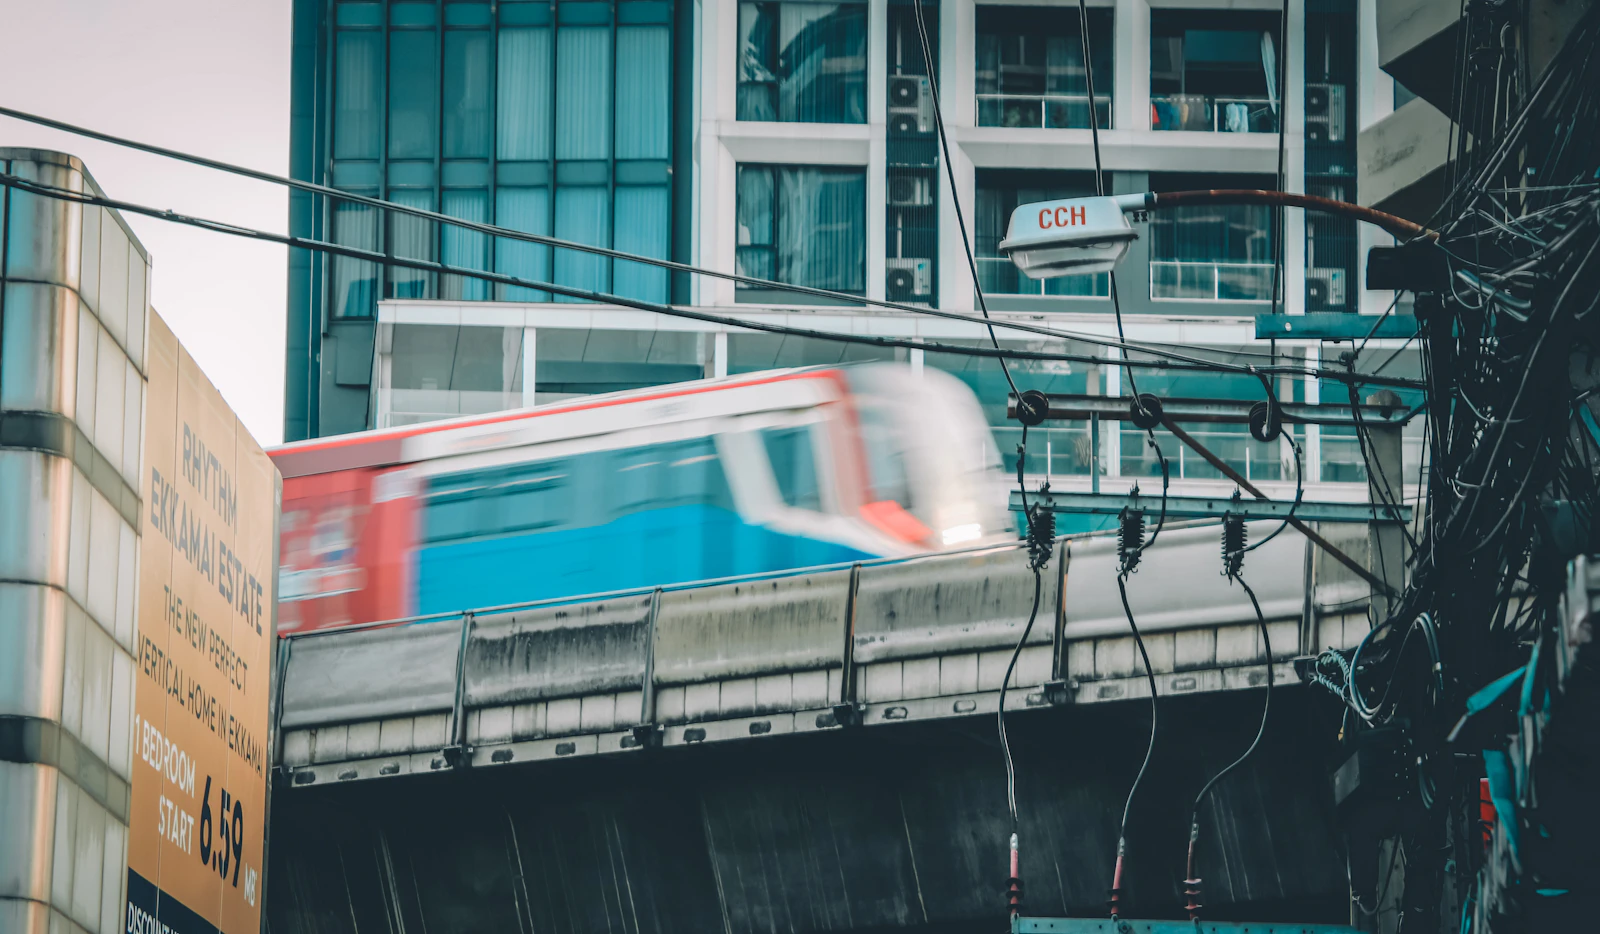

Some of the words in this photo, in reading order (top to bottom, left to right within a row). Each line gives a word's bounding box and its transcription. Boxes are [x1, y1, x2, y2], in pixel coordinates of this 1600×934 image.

[1038, 205, 1086, 229] CCH
[182, 421, 237, 532] RHYTHM
[151, 466, 215, 585] EKKAMAI
[219, 540, 262, 637] ESTATE
[164, 584, 182, 634] THE
[185, 605, 207, 656] NEW
[209, 629, 248, 695] PERFECT
[135, 714, 140, 754] 1
[142, 720, 196, 798] BEDROOM
[138, 629, 184, 706] VERTICAL
[188, 676, 216, 732] HOME
[218, 704, 226, 742] IN
[229, 714, 263, 779] EKKAMAI
[158, 795, 194, 855] START
[200, 775, 243, 888] 6.59
